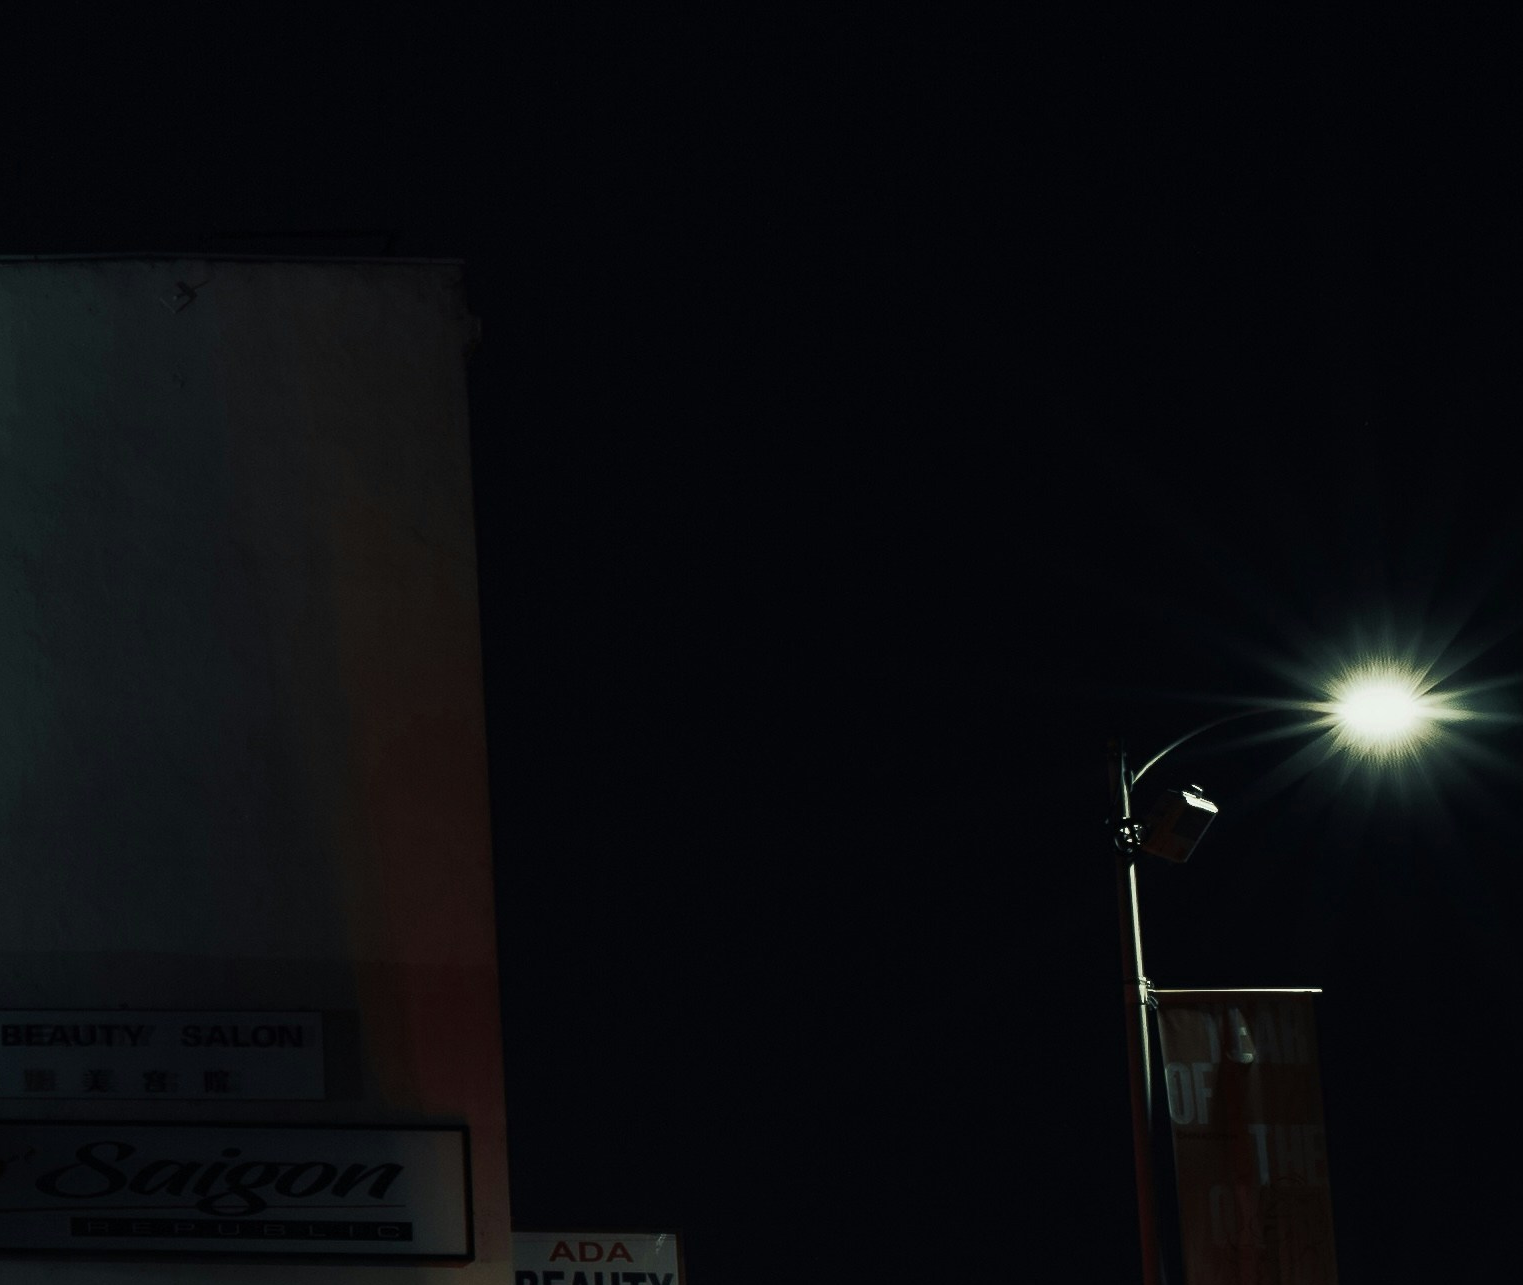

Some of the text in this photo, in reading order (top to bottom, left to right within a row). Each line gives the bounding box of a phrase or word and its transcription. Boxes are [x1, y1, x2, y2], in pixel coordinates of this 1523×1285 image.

[1, 1025, 148, 1047] BEAUTY
[180, 1025, 304, 1047] SALON
[1164, 1062, 1214, 1125] OF
[36, 1140, 405, 1217] Saigon
[85, 1218, 409, 1239] REPUBLIC
[549, 1241, 634, 1263] ADA
